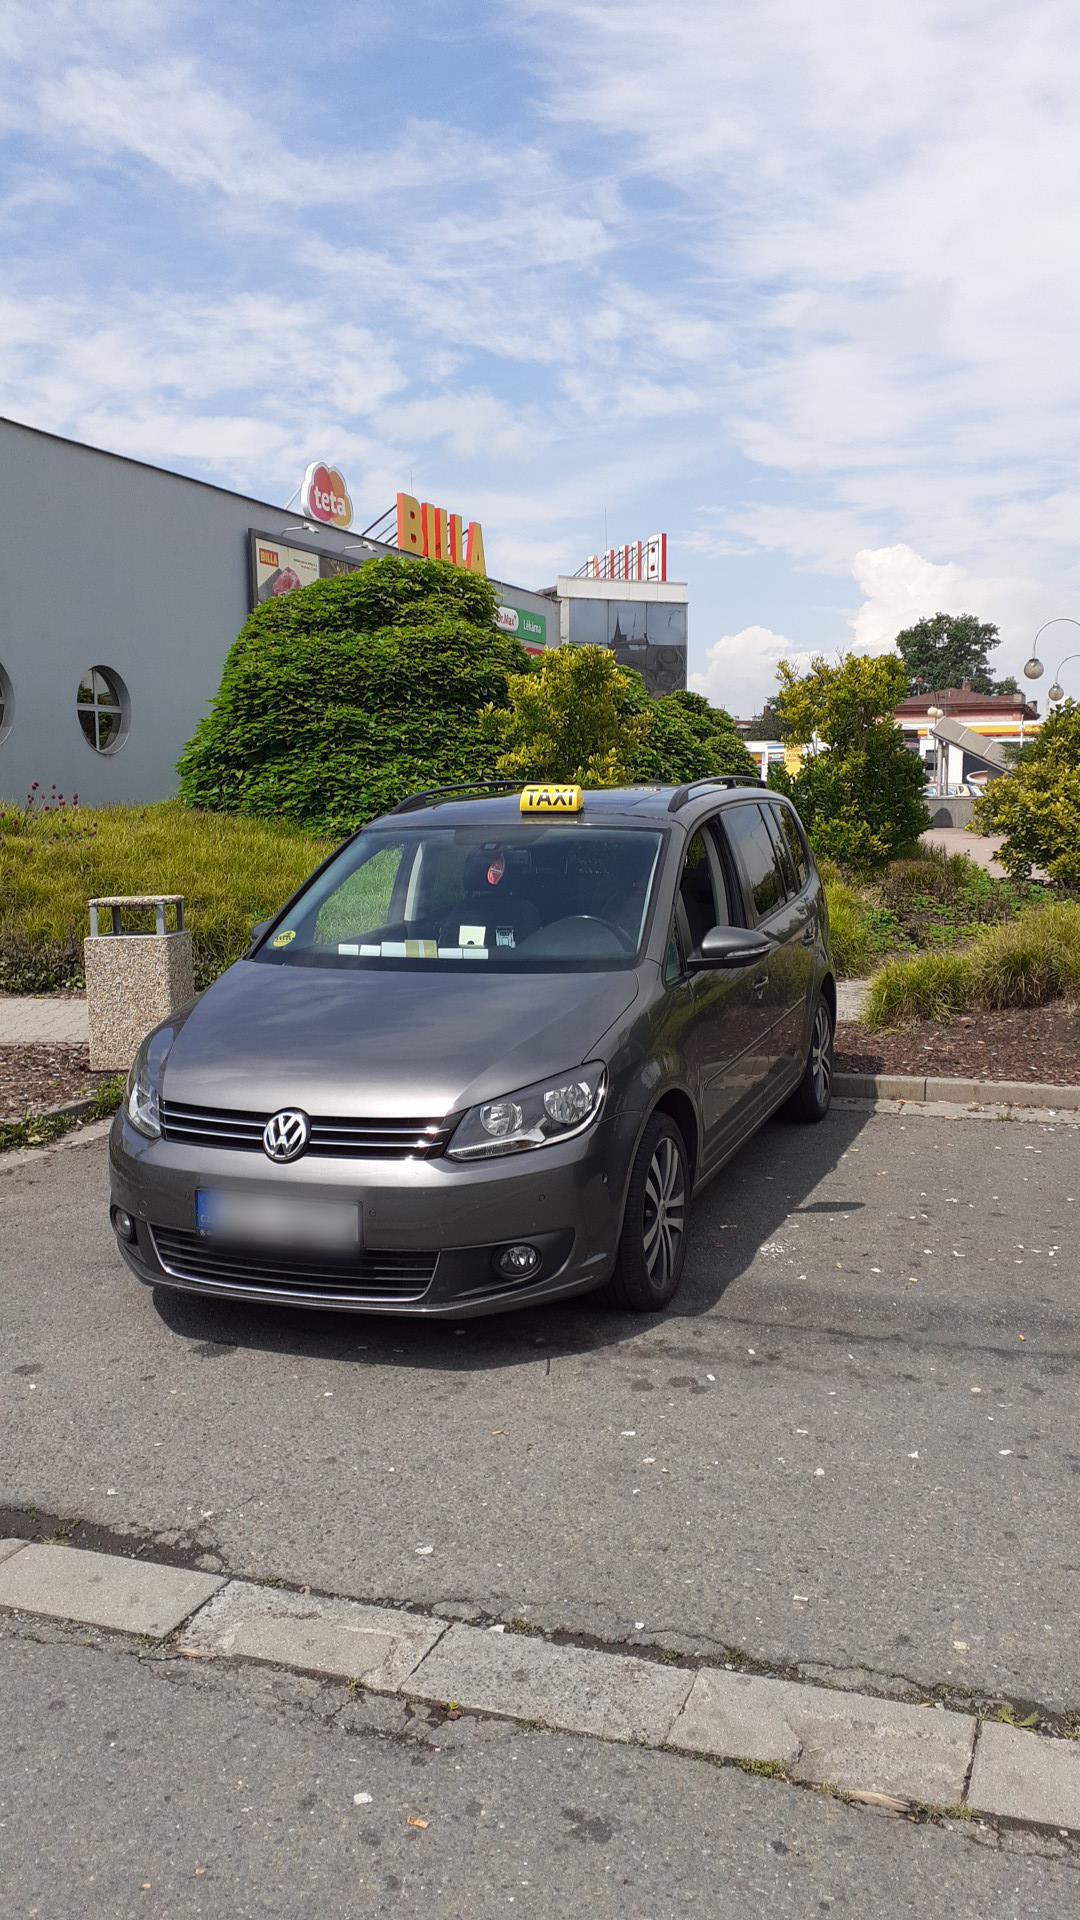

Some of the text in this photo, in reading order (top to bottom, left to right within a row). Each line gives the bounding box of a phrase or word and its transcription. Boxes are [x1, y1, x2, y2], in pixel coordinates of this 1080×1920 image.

[314, 486, 347, 517] teta
[397, 492, 486, 576] BILLA
[260, 550, 278, 566] BILLA
[526, 788, 574, 806] TAXI
